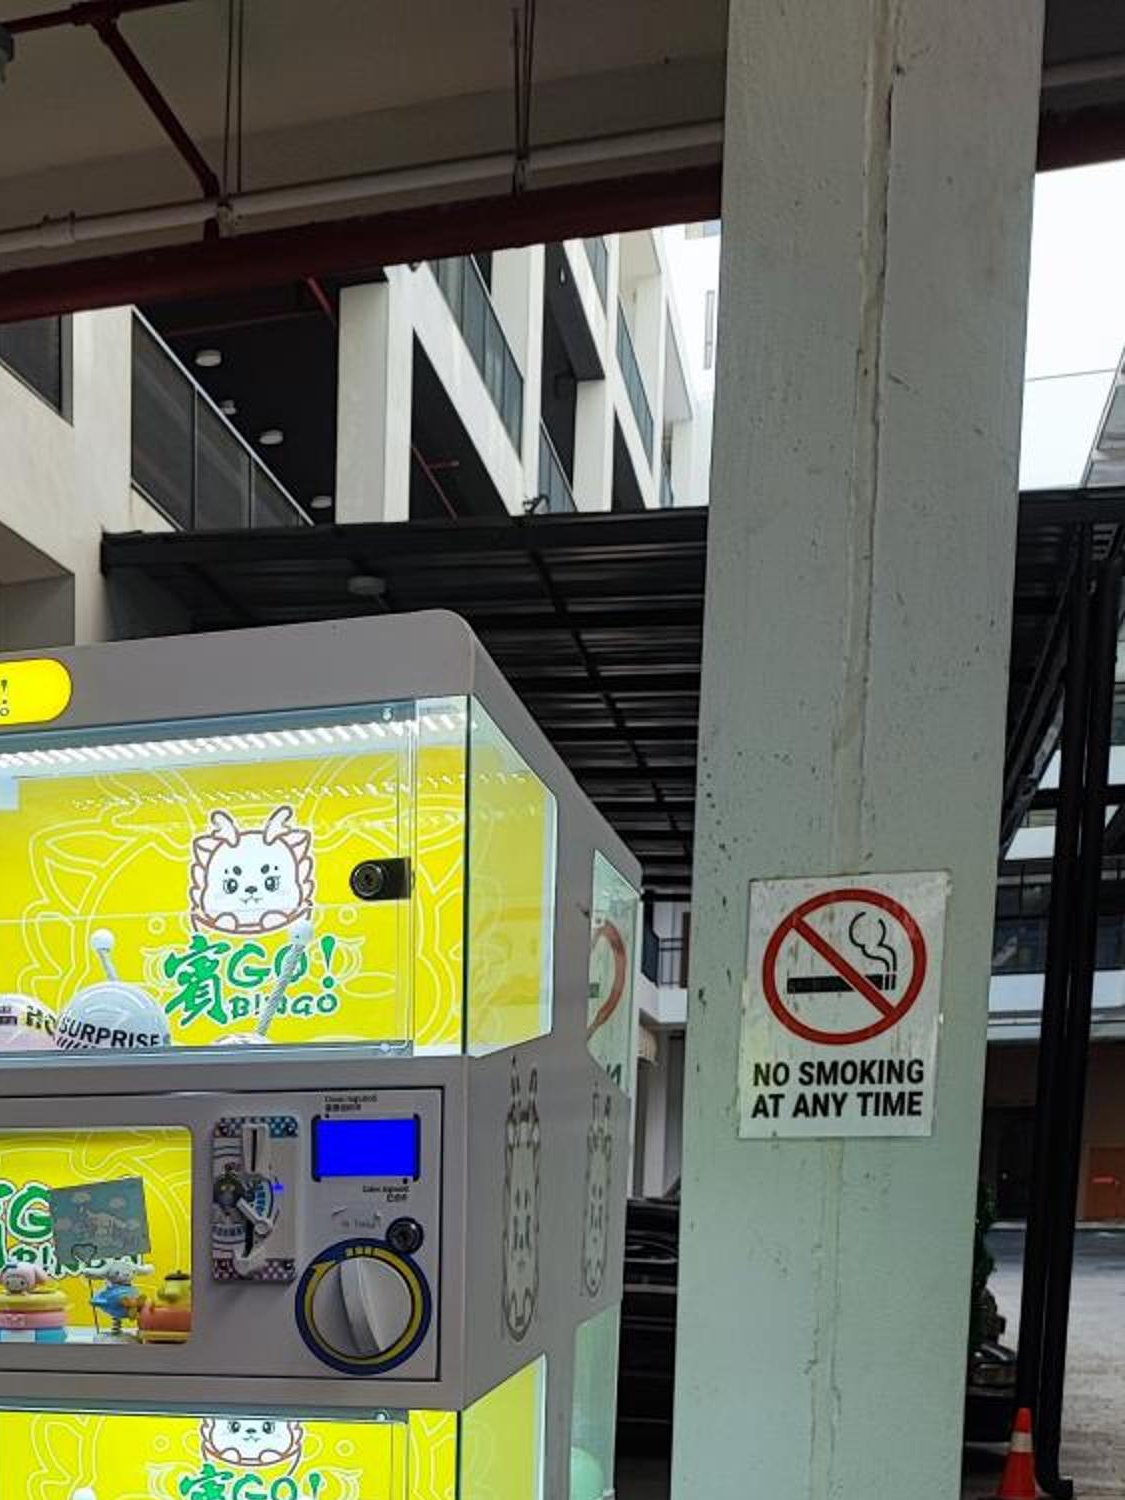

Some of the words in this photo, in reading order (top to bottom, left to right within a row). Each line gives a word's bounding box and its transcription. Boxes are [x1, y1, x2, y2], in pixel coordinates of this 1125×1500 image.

[753, 1062, 790, 1087] NO
[798, 1059, 924, 1086] SMOKING
[751, 1094, 785, 1118] AT
[792, 1092, 848, 1118] ANY
[857, 1091, 923, 1117] TIME
